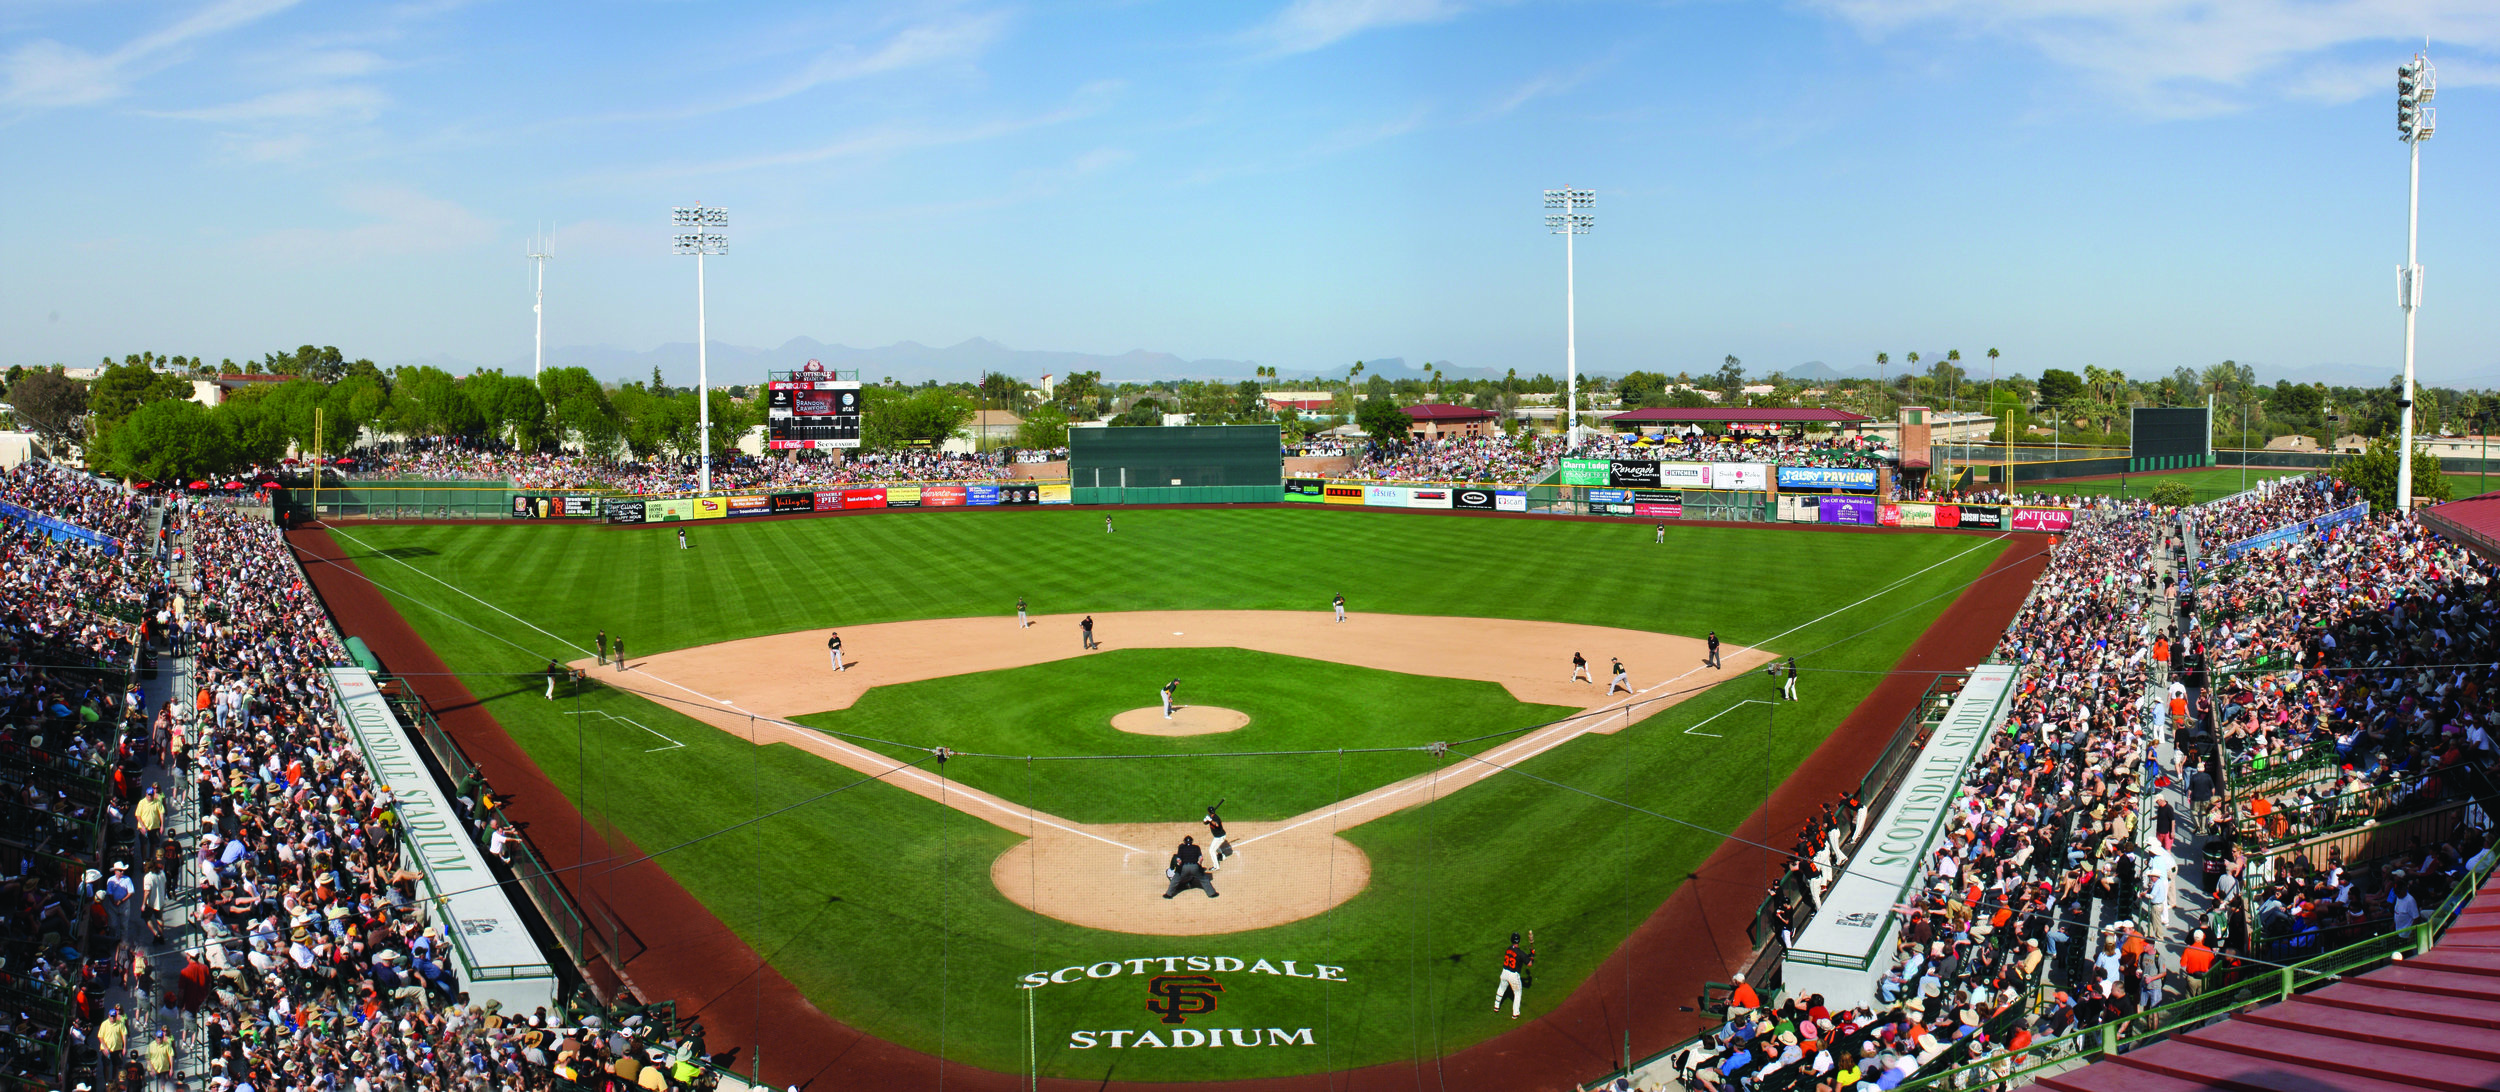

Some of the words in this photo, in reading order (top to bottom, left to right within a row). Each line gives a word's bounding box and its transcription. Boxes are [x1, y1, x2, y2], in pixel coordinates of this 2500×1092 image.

[795, 371, 833, 380] SCOTTSDALE
[774, 382, 808, 390] SUPERCUTS
[1563, 461, 1586, 469] Charro
[1588, 461, 1609, 470] Lodge
[1610, 462, 1654, 478] Renegade
[920, 487, 951, 498] elevate
[1327, 488, 1361, 496] BANDERA
[821, 496, 838, 504] PIE
[1961, 513, 1979, 522] SUSHI
[2013, 510, 2070, 523] ANTIGUA
[349, 701, 418, 780] SCOTTSDALE
[395, 789, 473, 873] STADIUM
[1869, 754, 1963, 868] SCOTTSDALE
[1939, 698, 1994, 749] STADIUM
[1020, 956, 1348, 989] SCOTTSDALE
[1145, 974, 1227, 1025] SF
[1069, 1028, 1317, 1049] STADIUM
